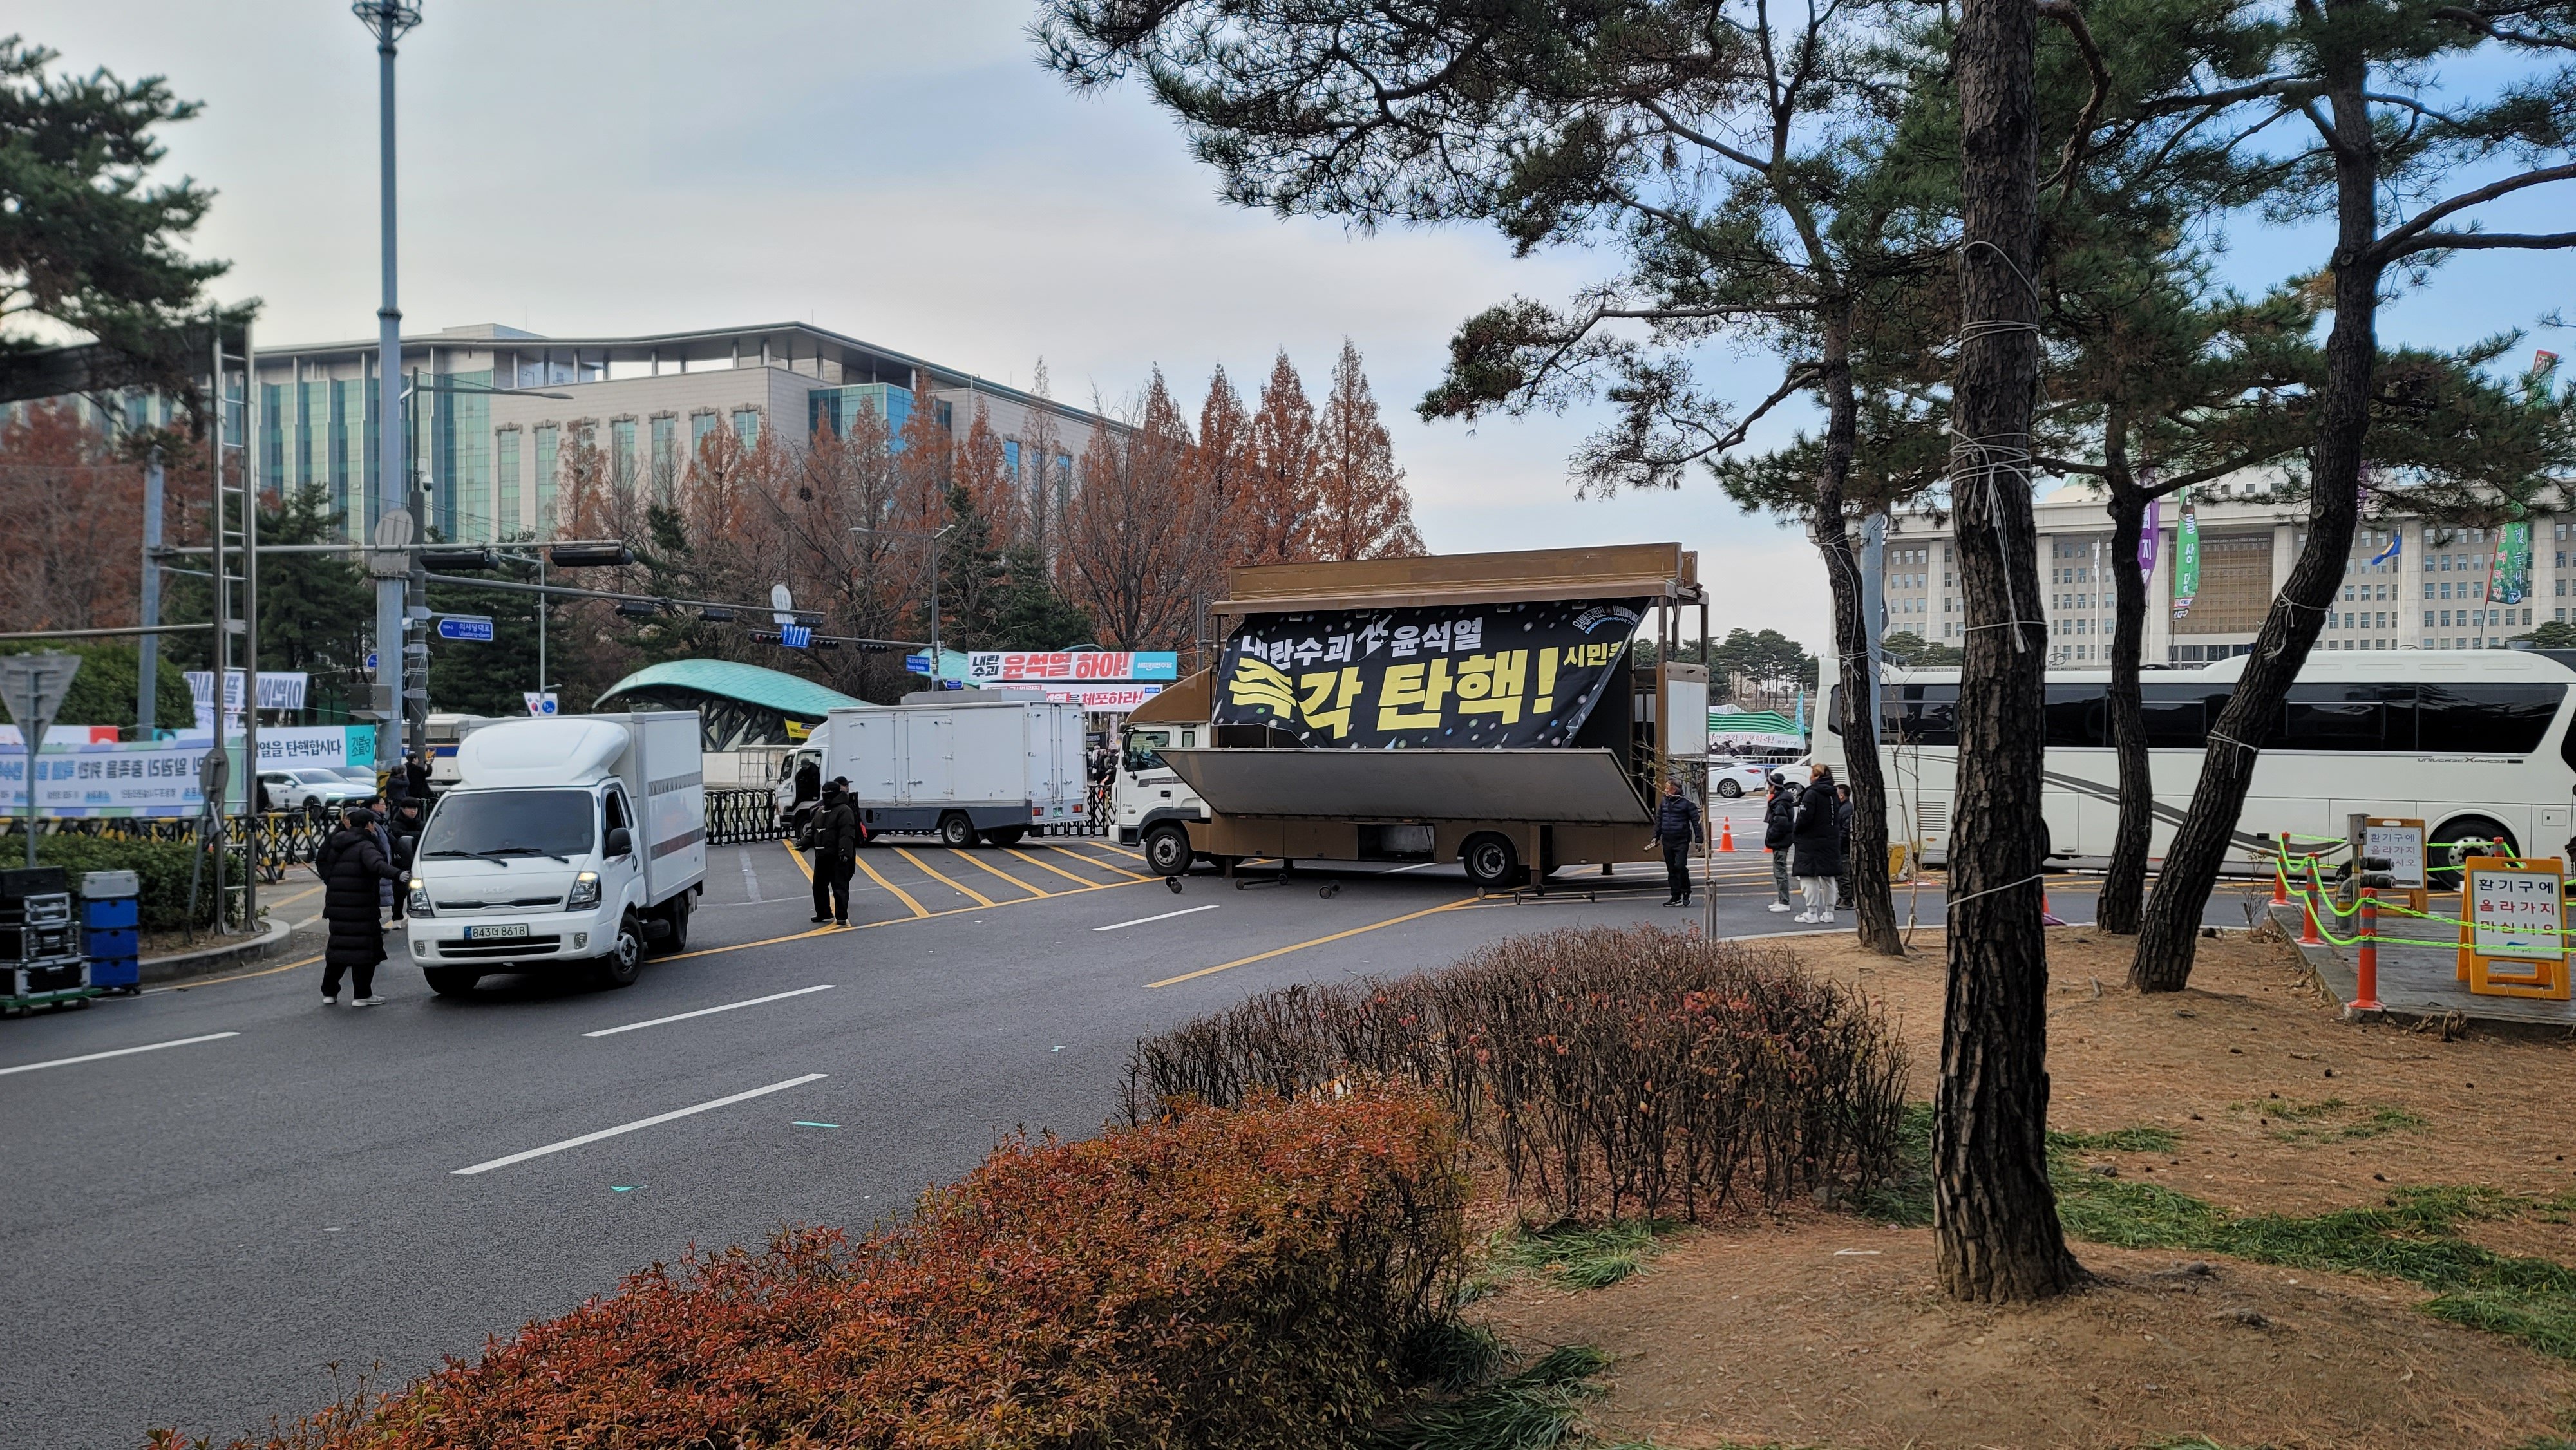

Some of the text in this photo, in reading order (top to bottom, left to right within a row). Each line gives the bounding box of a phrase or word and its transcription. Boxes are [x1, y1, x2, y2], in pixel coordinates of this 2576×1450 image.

[1241, 617, 1483, 670] 내란수괴 윤석열
[972, 655, 999, 666] 내란
[1003, 652, 1130, 680] 윤석열 하야!
[972, 666, 999, 677] 수괴
[1082, 691, 1144, 706] 체포하라!
[1229, 646, 1558, 739] 즉각 탄핵!
[256, 739, 341, 758] 열을 탄핵합시다
[2371, 834, 2415, 842] 환기구에
[2371, 846, 2415, 855] 올라가지
[2479, 879, 2553, 894] 환기구에
[2479, 899, 2555, 916] 올라가지
[473, 927, 525, 937] 843더 8618
